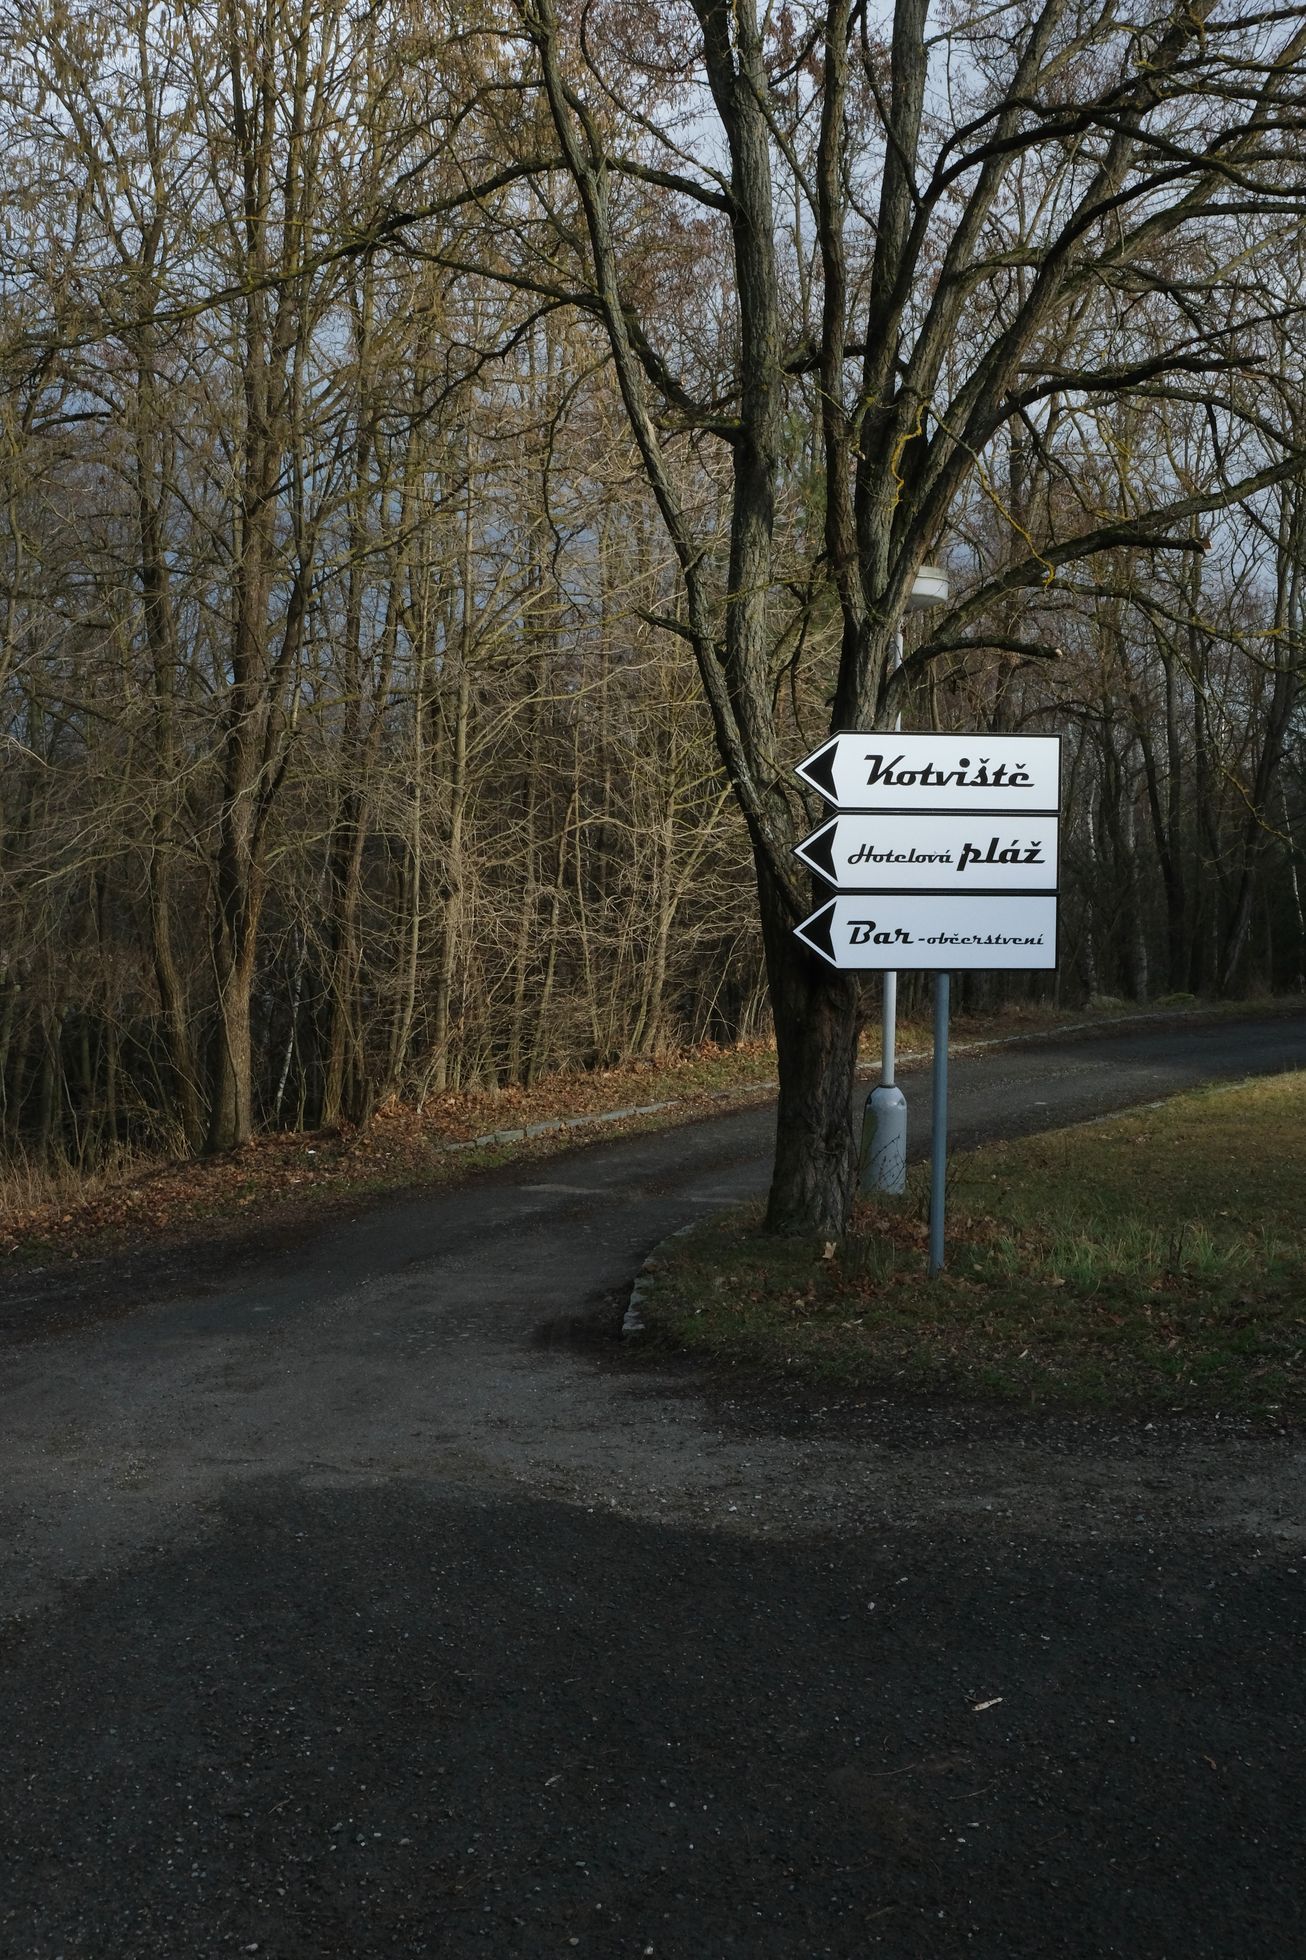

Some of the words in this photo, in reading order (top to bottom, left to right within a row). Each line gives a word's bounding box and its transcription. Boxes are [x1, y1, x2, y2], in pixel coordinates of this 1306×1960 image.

[865, 755, 1035, 787] Kotviště
[847, 844, 954, 866] Hotelová
[957, 837, 1046, 871] pláž
